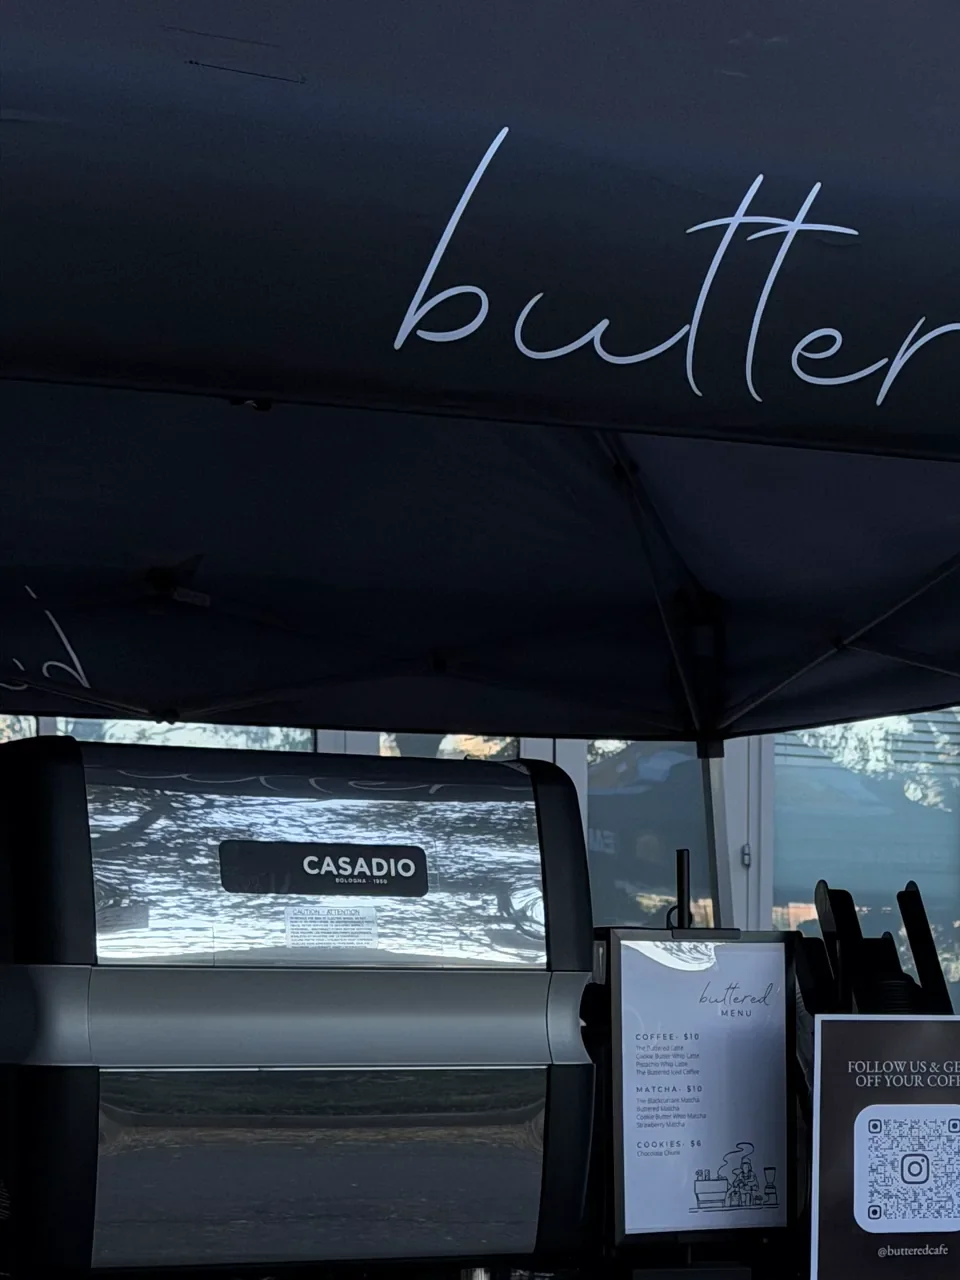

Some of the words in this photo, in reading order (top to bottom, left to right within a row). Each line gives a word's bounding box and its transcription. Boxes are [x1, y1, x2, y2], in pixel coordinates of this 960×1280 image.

[303, 856, 416, 877] CASADIO
[699, 981, 774, 1007] buttered
[721, 1009, 752, 1017] MENU
[683, 1032, 700, 1041] $10
[848, 1060, 907, 1073] FOLLOW
[909, 1060, 927, 1073] US
[929, 1061, 940, 1073] &
[856, 1075, 882, 1087] OFF
[884, 1075, 924, 1087] YOUR
[687, 1085, 703, 1093] $10
[690, 1139, 702, 1148] $6
[877, 1243, 949, 1258] @butteredcafe
